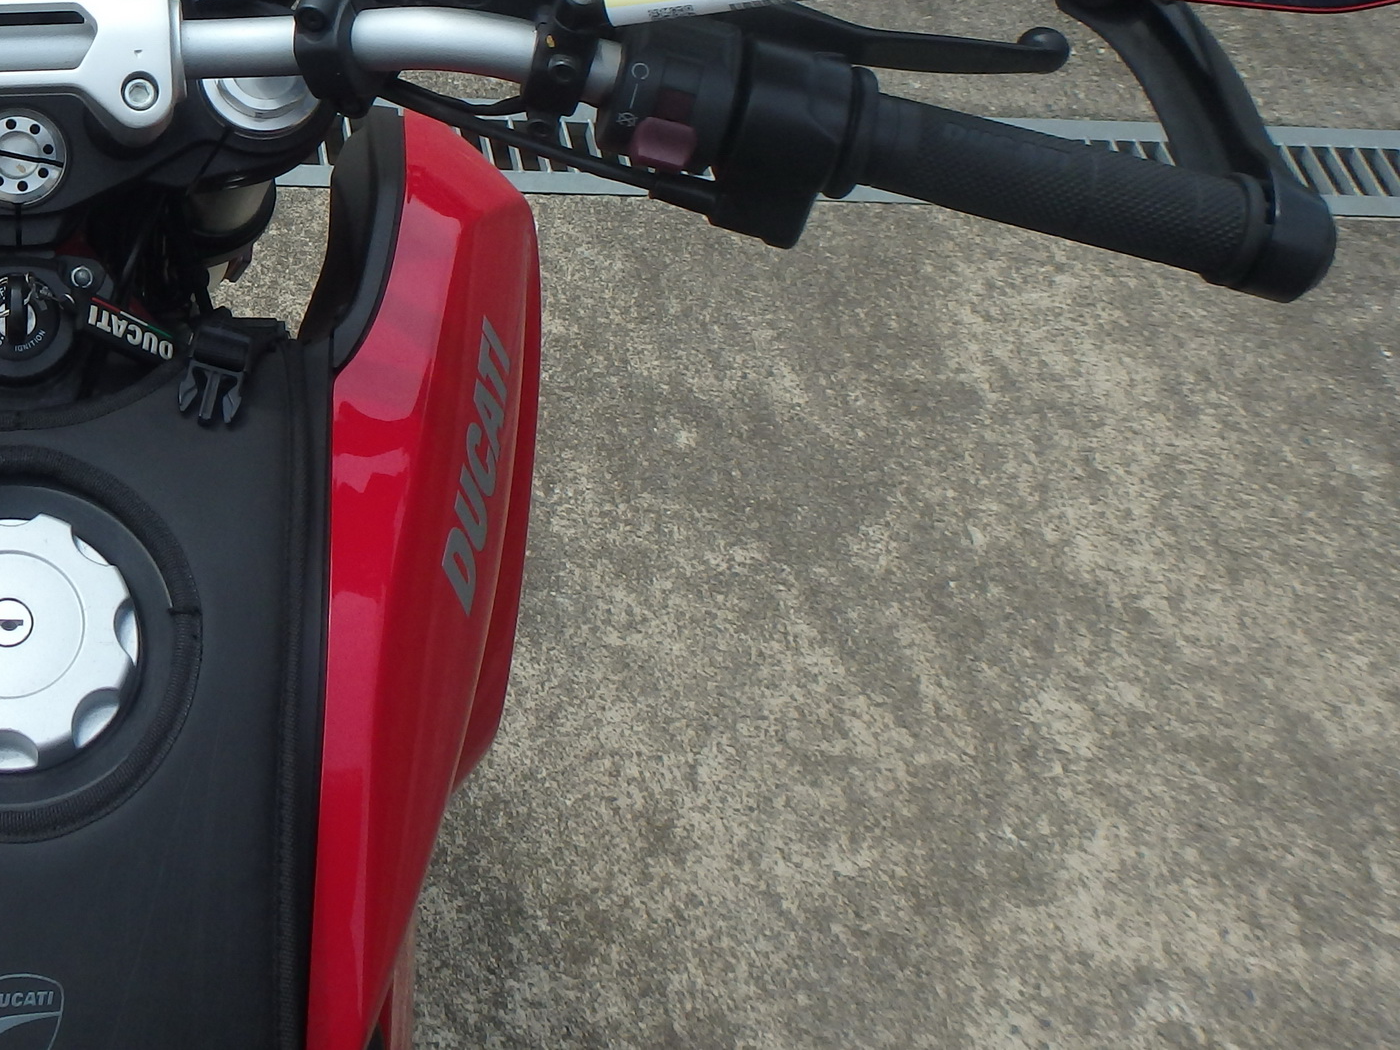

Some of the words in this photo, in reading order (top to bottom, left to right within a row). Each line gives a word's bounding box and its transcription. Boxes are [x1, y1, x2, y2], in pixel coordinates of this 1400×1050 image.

[14, 329, 46, 352] IGNITION
[86, 304, 175, 362] DUCATI
[442, 314, 511, 617] DUCATI
